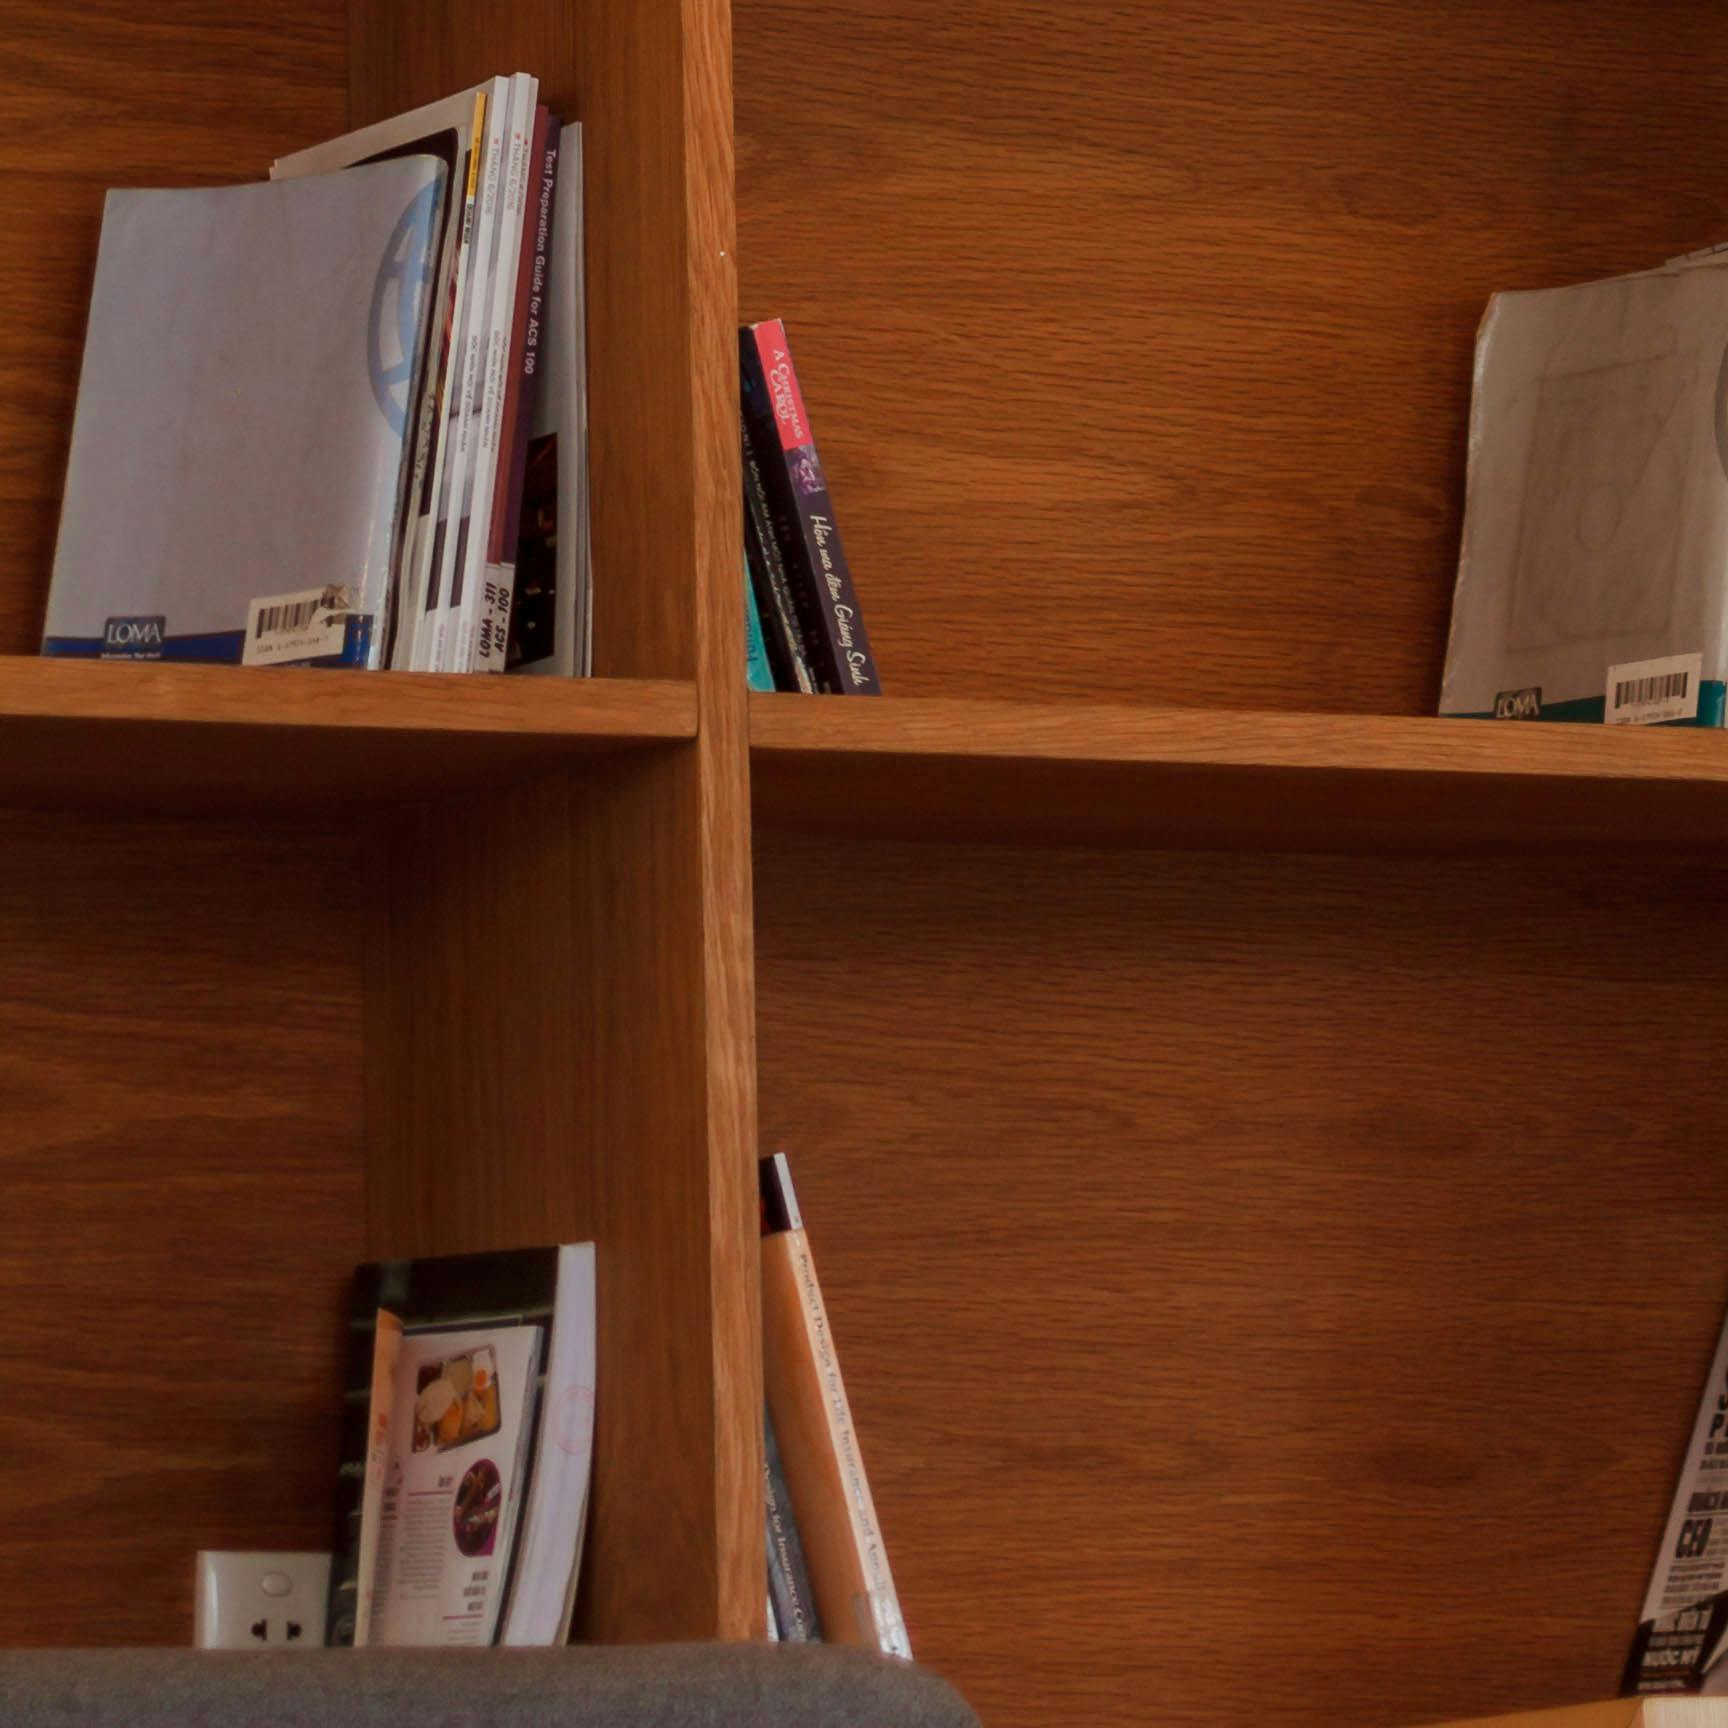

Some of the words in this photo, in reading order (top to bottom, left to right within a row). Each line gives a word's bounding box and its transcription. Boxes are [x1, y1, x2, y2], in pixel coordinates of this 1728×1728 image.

[544, 148, 558, 167] Test
[535, 167, 556, 252] Preparation
[532, 253, 547, 294] Guide
[531, 295, 542, 315] for
[525, 315, 541, 348] ACS
[523, 352, 536, 375] 100
[772, 348, 785, 362] A
[769, 368, 791, 426] CAROL
[778, 362, 804, 440] CHRISTMAS
[485, 582, 498, 607] 311
[498, 587, 511, 613] 100
[107, 622, 163, 645] LOMA
[478, 618, 493, 658] LOMA
[494, 625, 506, 654] ACS
[833, 603, 855, 650] Giáng
[845, 650, 867, 687] Sinh
[799, 1253, 821, 1315] Product
[812, 1315, 832, 1367] Design
[826, 1368, 838, 1394] for
[837, 1428, 867, 1506] Insurance
[772, 1508, 784, 1532] for
[776, 1532, 802, 1601] Insurance
